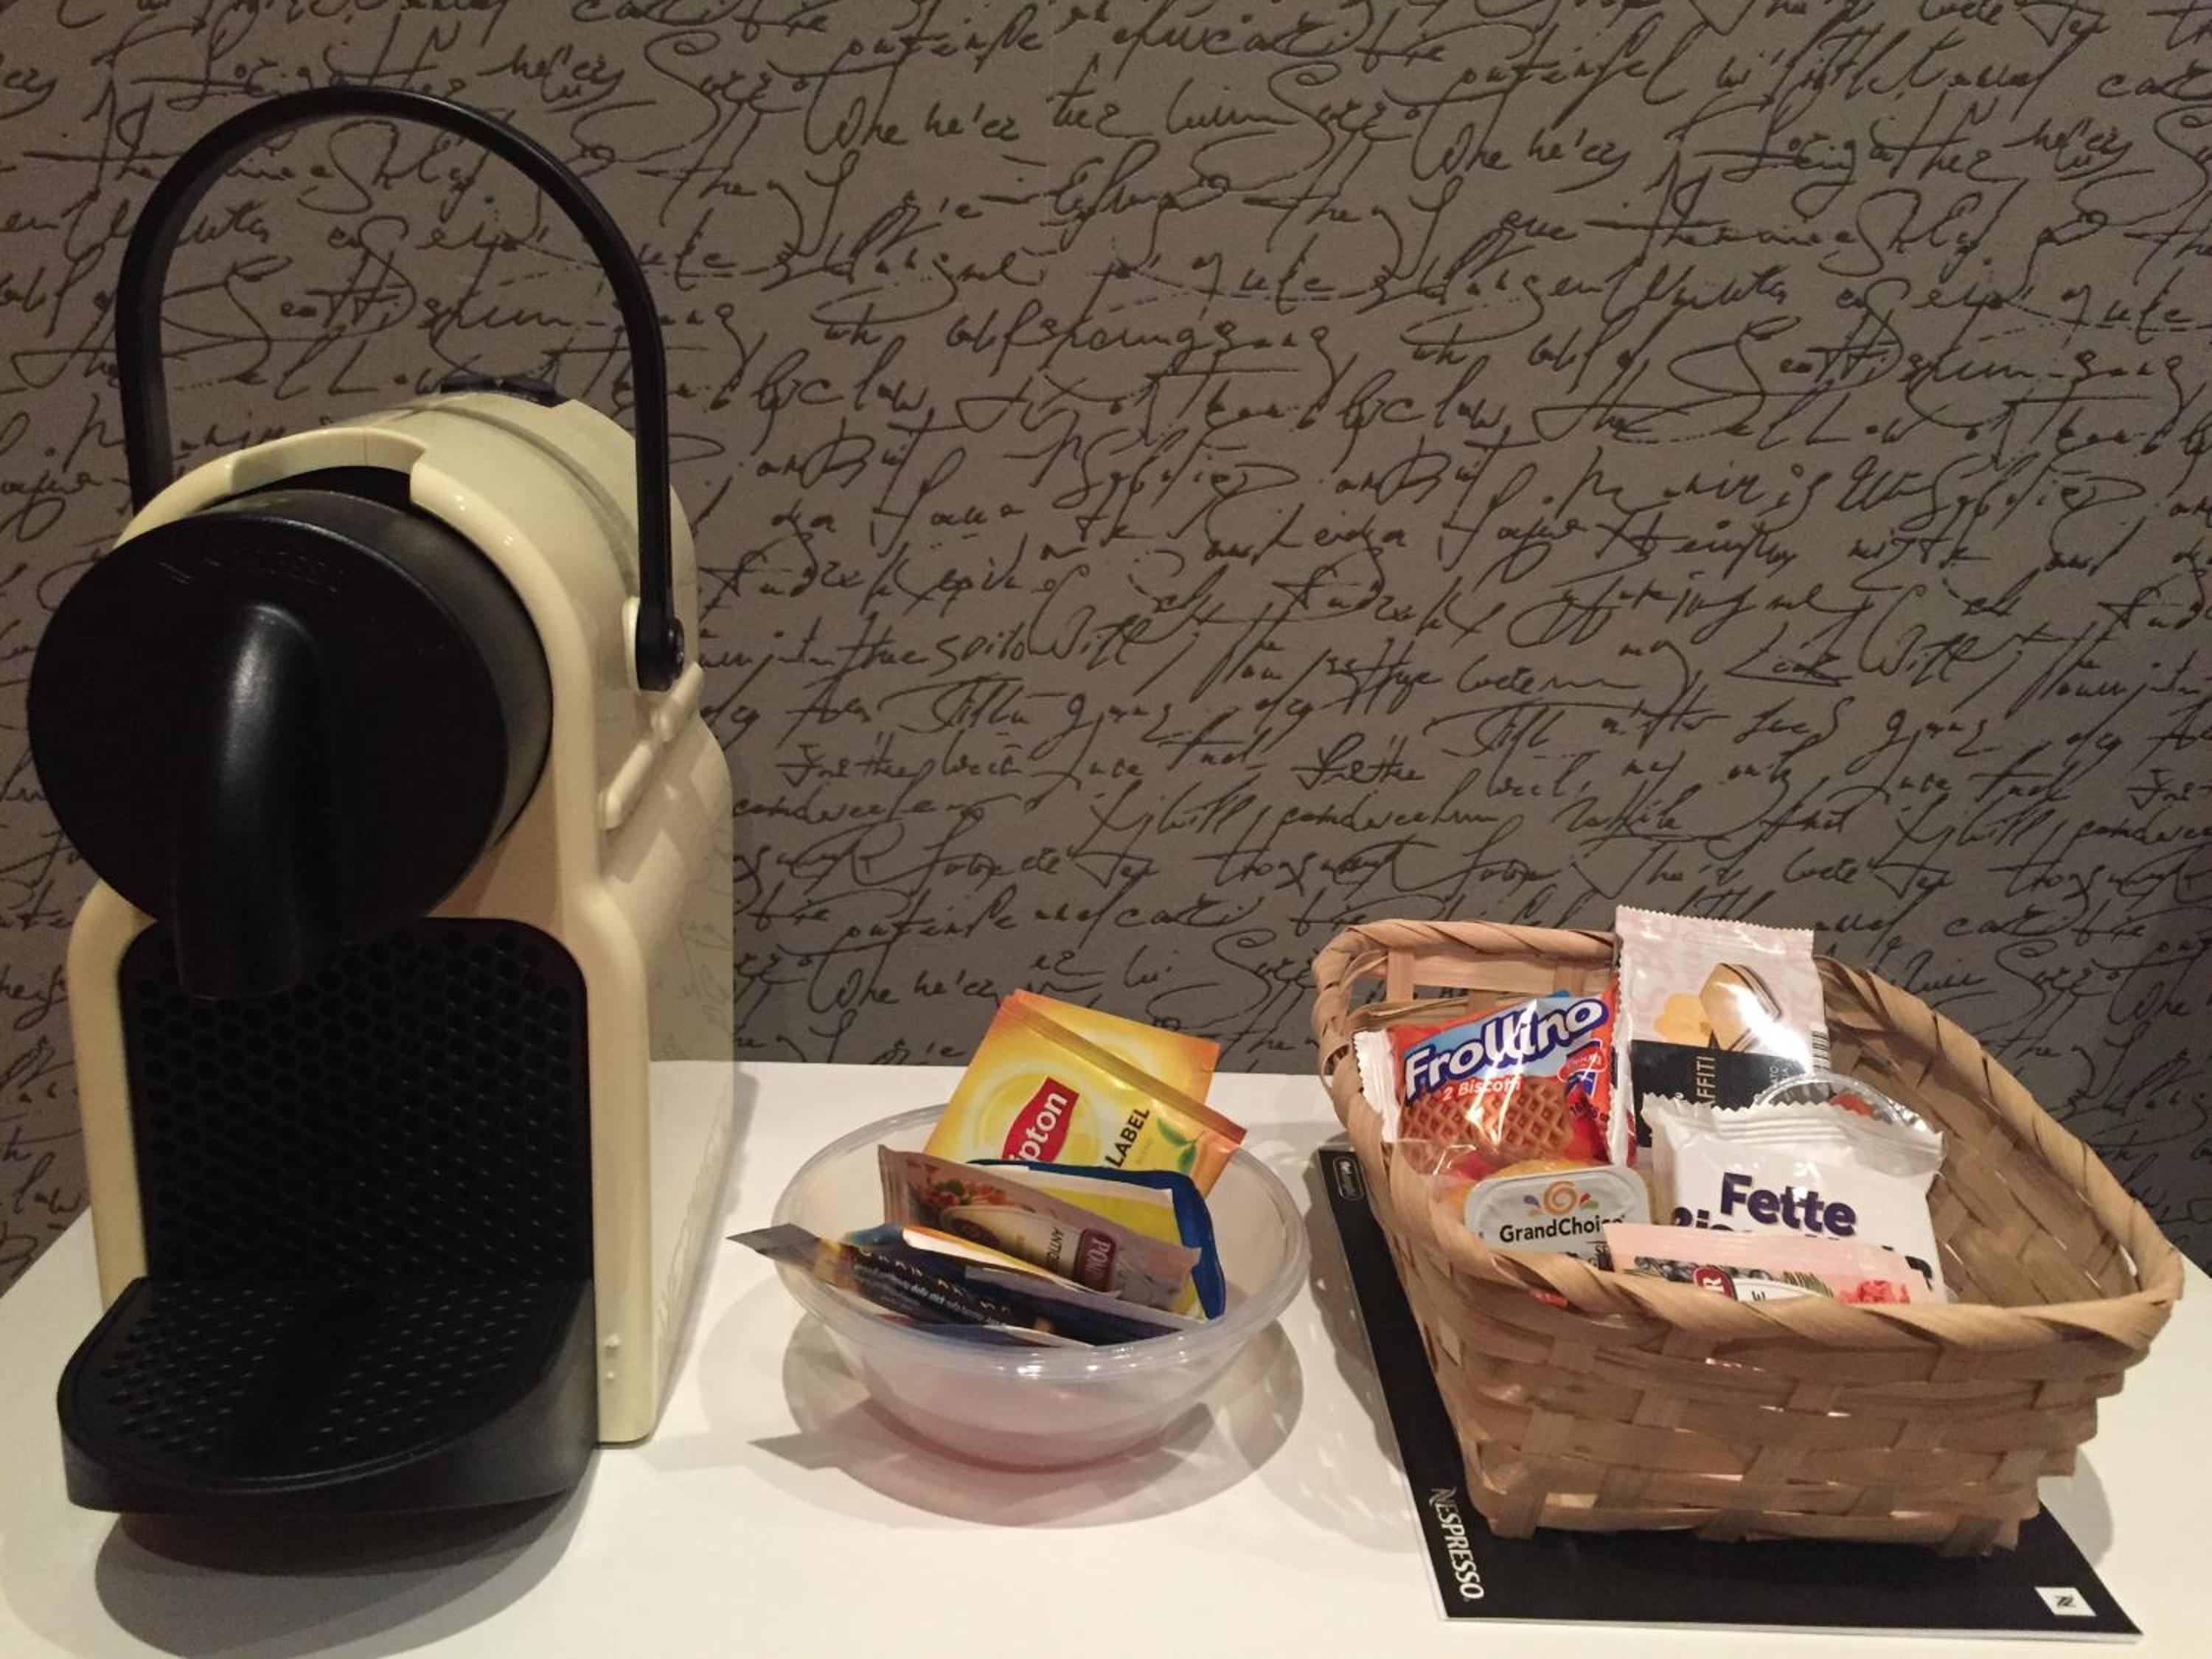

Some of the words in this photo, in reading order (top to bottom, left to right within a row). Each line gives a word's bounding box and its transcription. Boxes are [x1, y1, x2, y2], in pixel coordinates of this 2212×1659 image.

[1403, 998, 1610, 1107] Frollino
[1442, 1086, 1453, 1101] 2
[1009, 1092, 1068, 1162] pton
[1105, 1108, 1150, 1168] LABEL
[1499, 1215, 1623, 1243] GrandChoi
[1720, 1171, 1857, 1237] Fette
[1428, 1486, 1485, 1599] NESPRESSO
